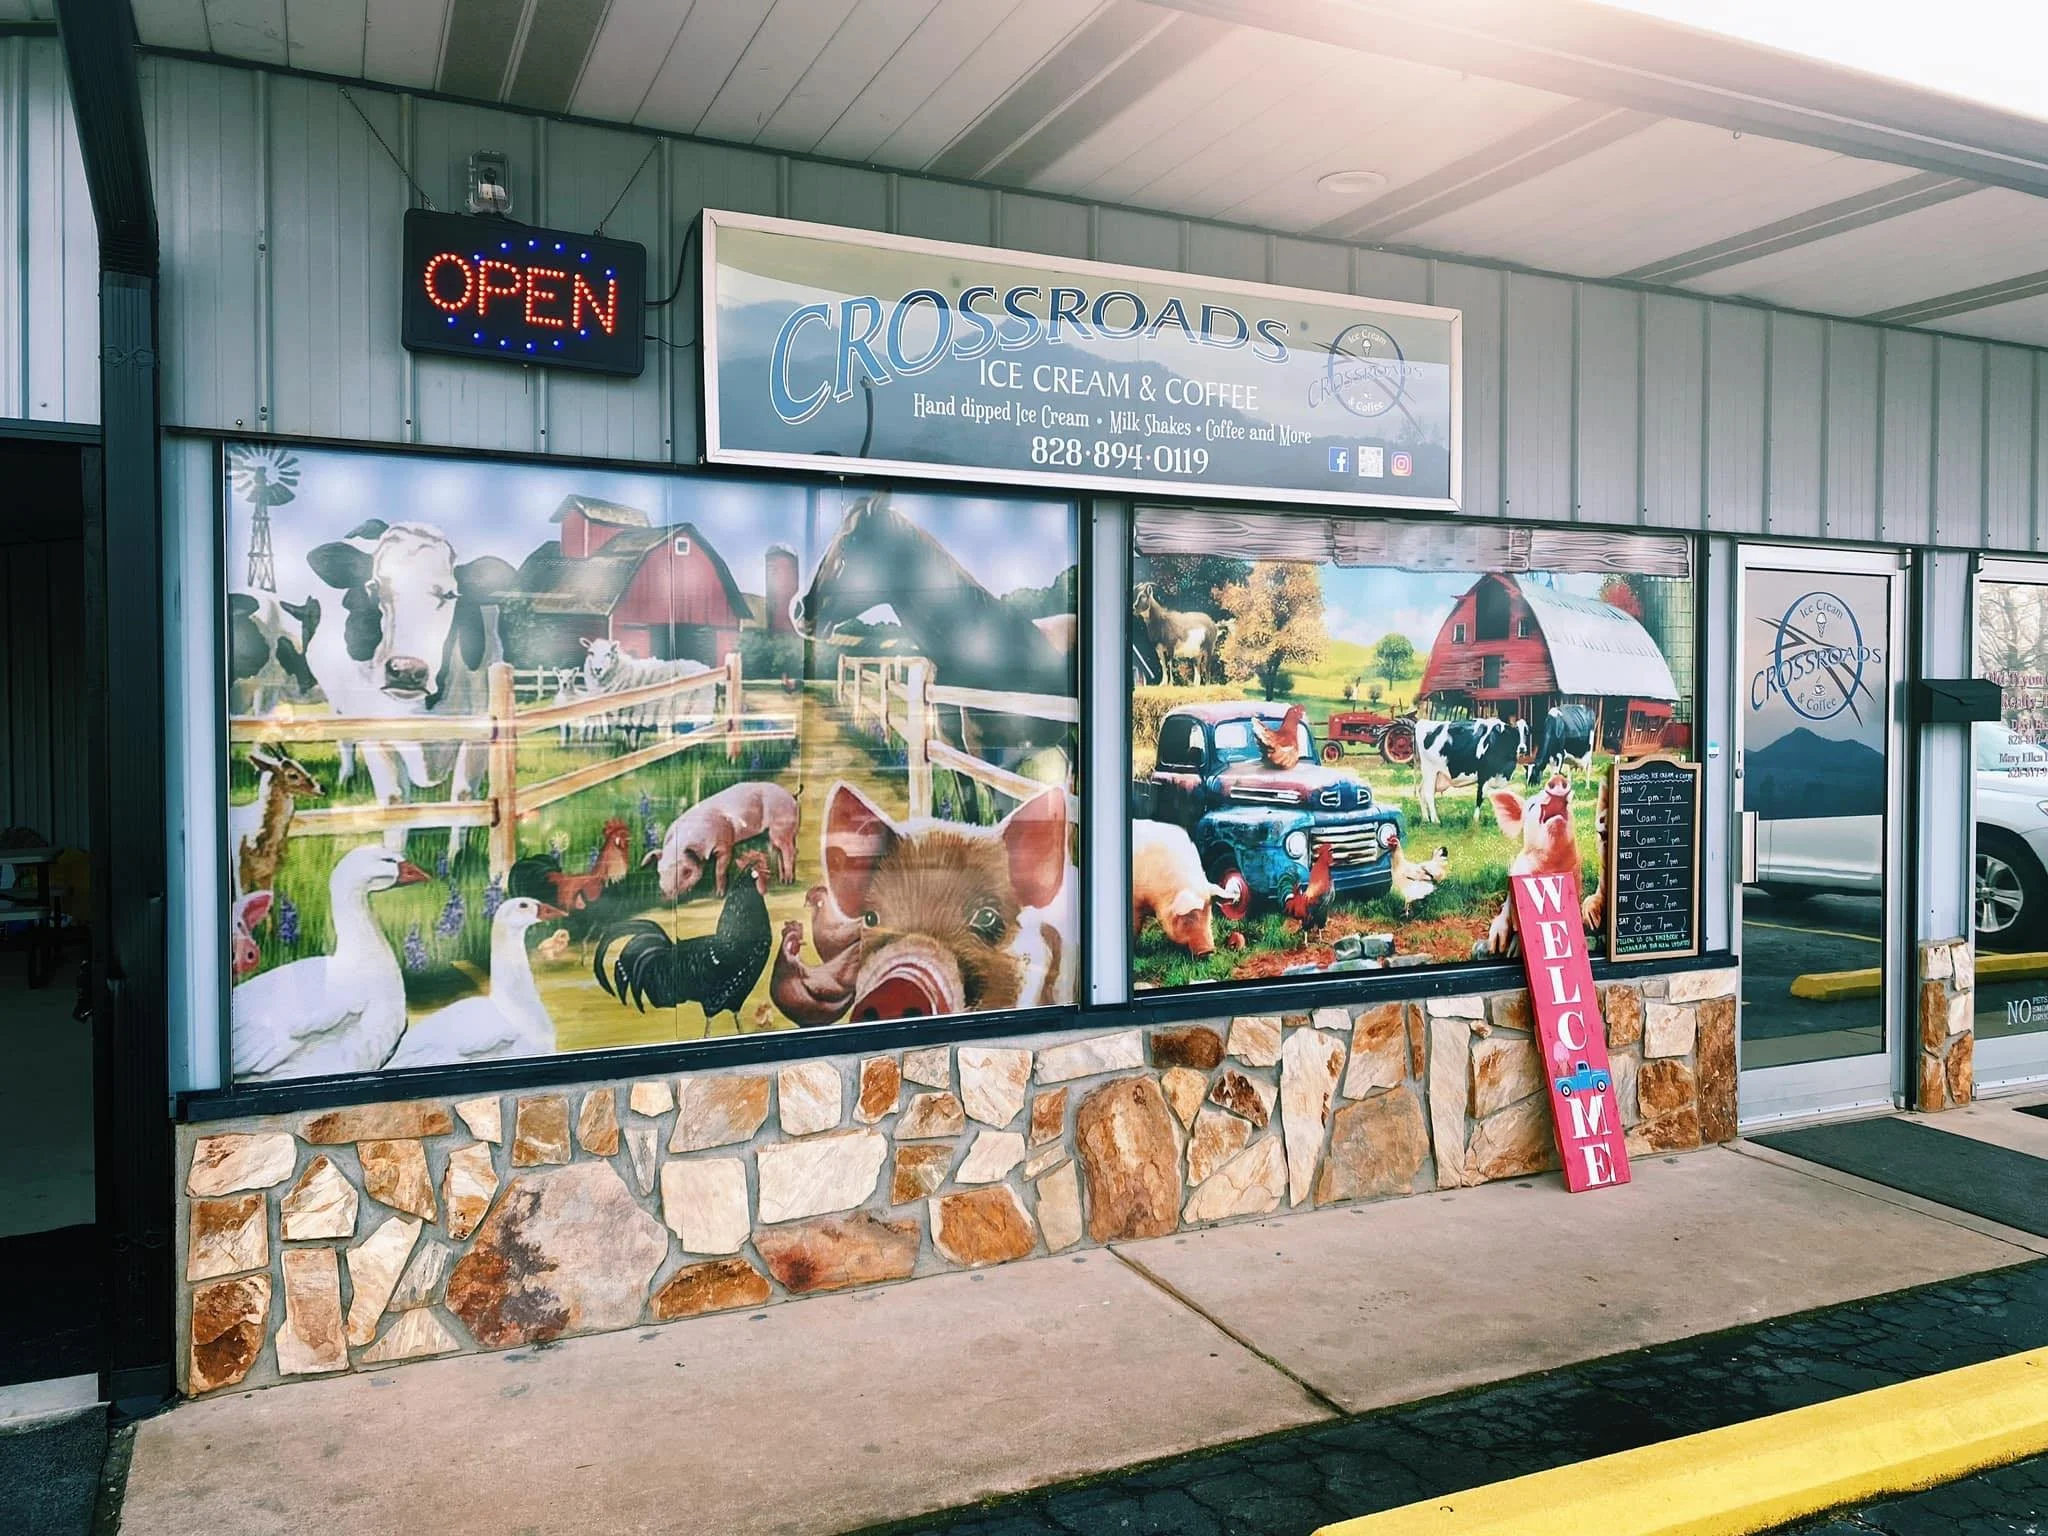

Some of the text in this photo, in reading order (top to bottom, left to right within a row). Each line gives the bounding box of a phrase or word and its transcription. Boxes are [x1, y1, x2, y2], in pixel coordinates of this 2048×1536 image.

[424, 252, 617, 335] OPEN
[1348, 329, 1388, 346] Ice Cream
[768, 285, 1291, 426] CROSSROADS
[980, 359, 1259, 411] ICE CREAM & COFFEE
[1308, 365, 1424, 409] CROSSROADS
[913, 392, 1312, 447] Hand dipped Ice Cream Milk Shakes Coffee and More
[1356, 402, 1385, 414] Coffee
[1800, 599, 1844, 620] Ice Cream
[1751, 647, 1882, 711] CROSSROADS
[1806, 696, 1837, 712] Coffee
[1619, 873, 1631, 881] THU
[1619, 895, 1628, 903] FRI
[1619, 917, 1629, 925] SAT
[2007, 999, 2031, 1025] NO
